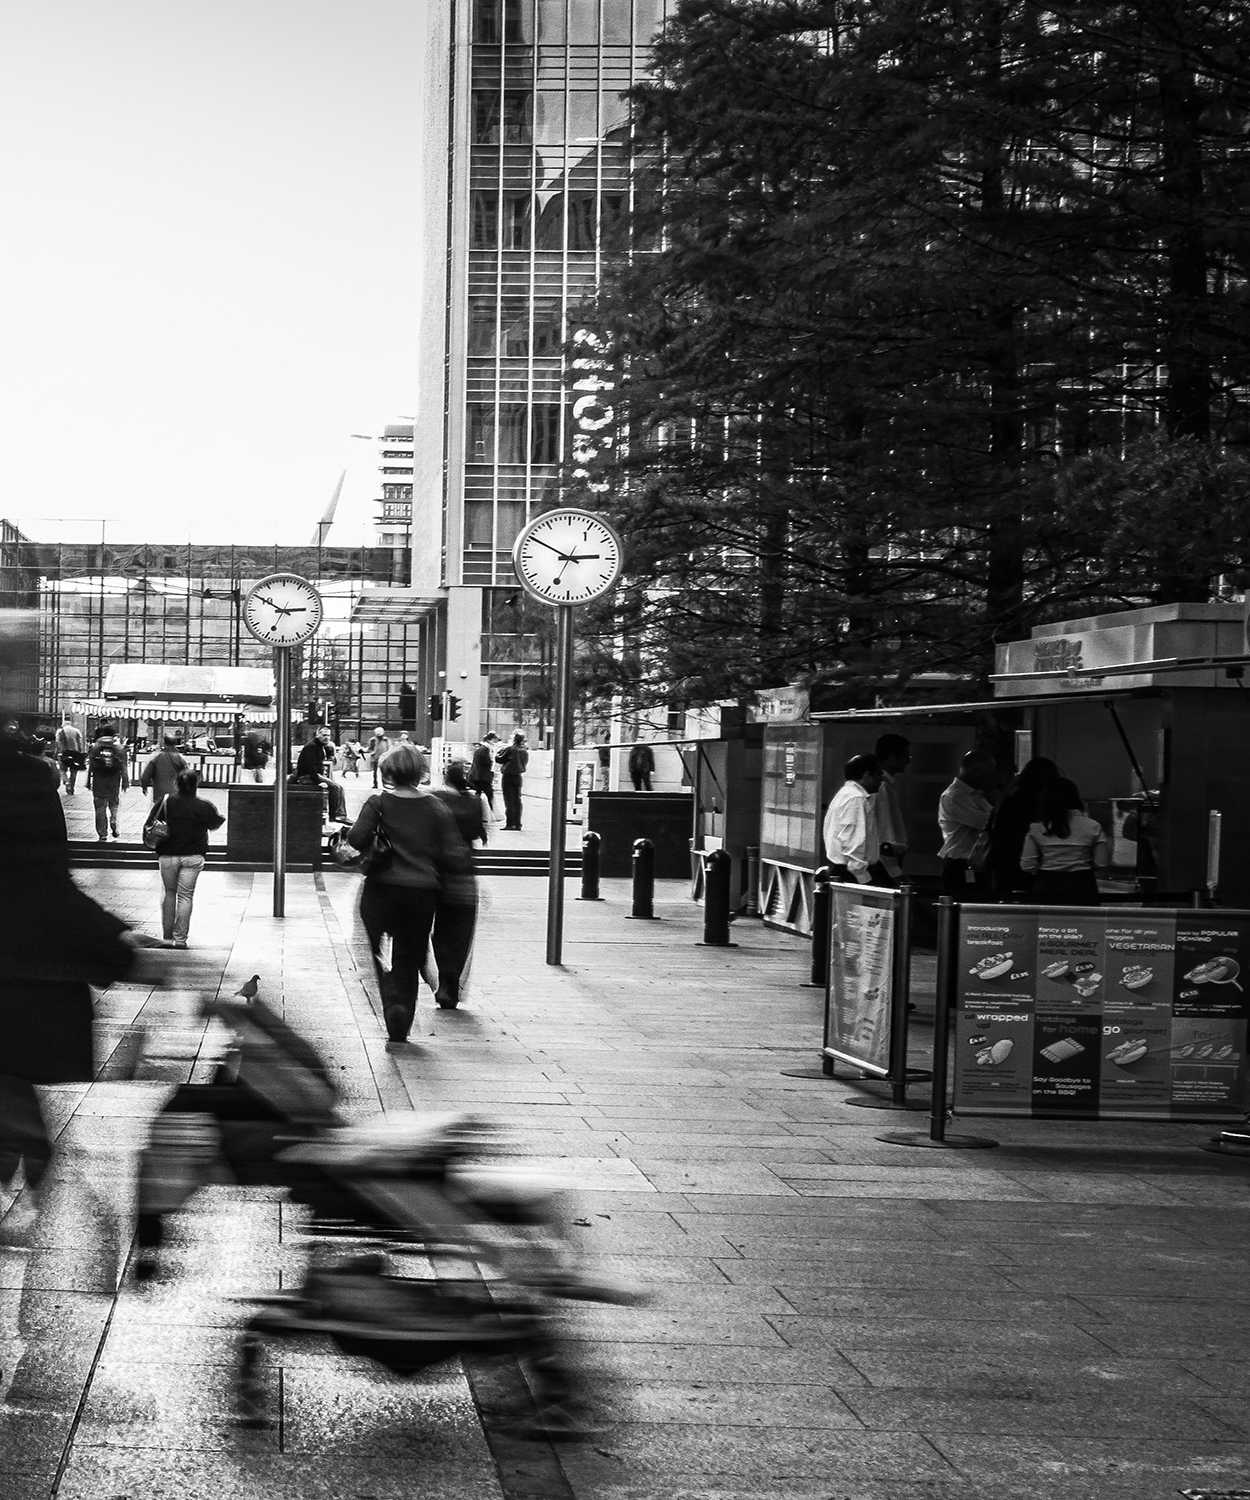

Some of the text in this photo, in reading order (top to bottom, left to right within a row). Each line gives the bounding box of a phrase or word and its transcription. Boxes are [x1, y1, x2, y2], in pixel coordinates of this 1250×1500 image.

[582, 530, 588, 542] 1
[1046, 940, 1099, 948] GOURMET
[1109, 943, 1175, 951] VEGETARIAN
[1070, 949, 1099, 957] DEAL
[976, 1014, 1029, 1023] wrapped
[1035, 1016, 1076, 1024] hotdogs
[1103, 1018, 1144, 1026] hotdogs
[1059, 1025, 1098, 1034] home
[1102, 1025, 1167, 1035] go gourmet!
[1048, 1076, 1081, 1084] Goodbye
[1055, 1083, 1092, 1091] Sausages
